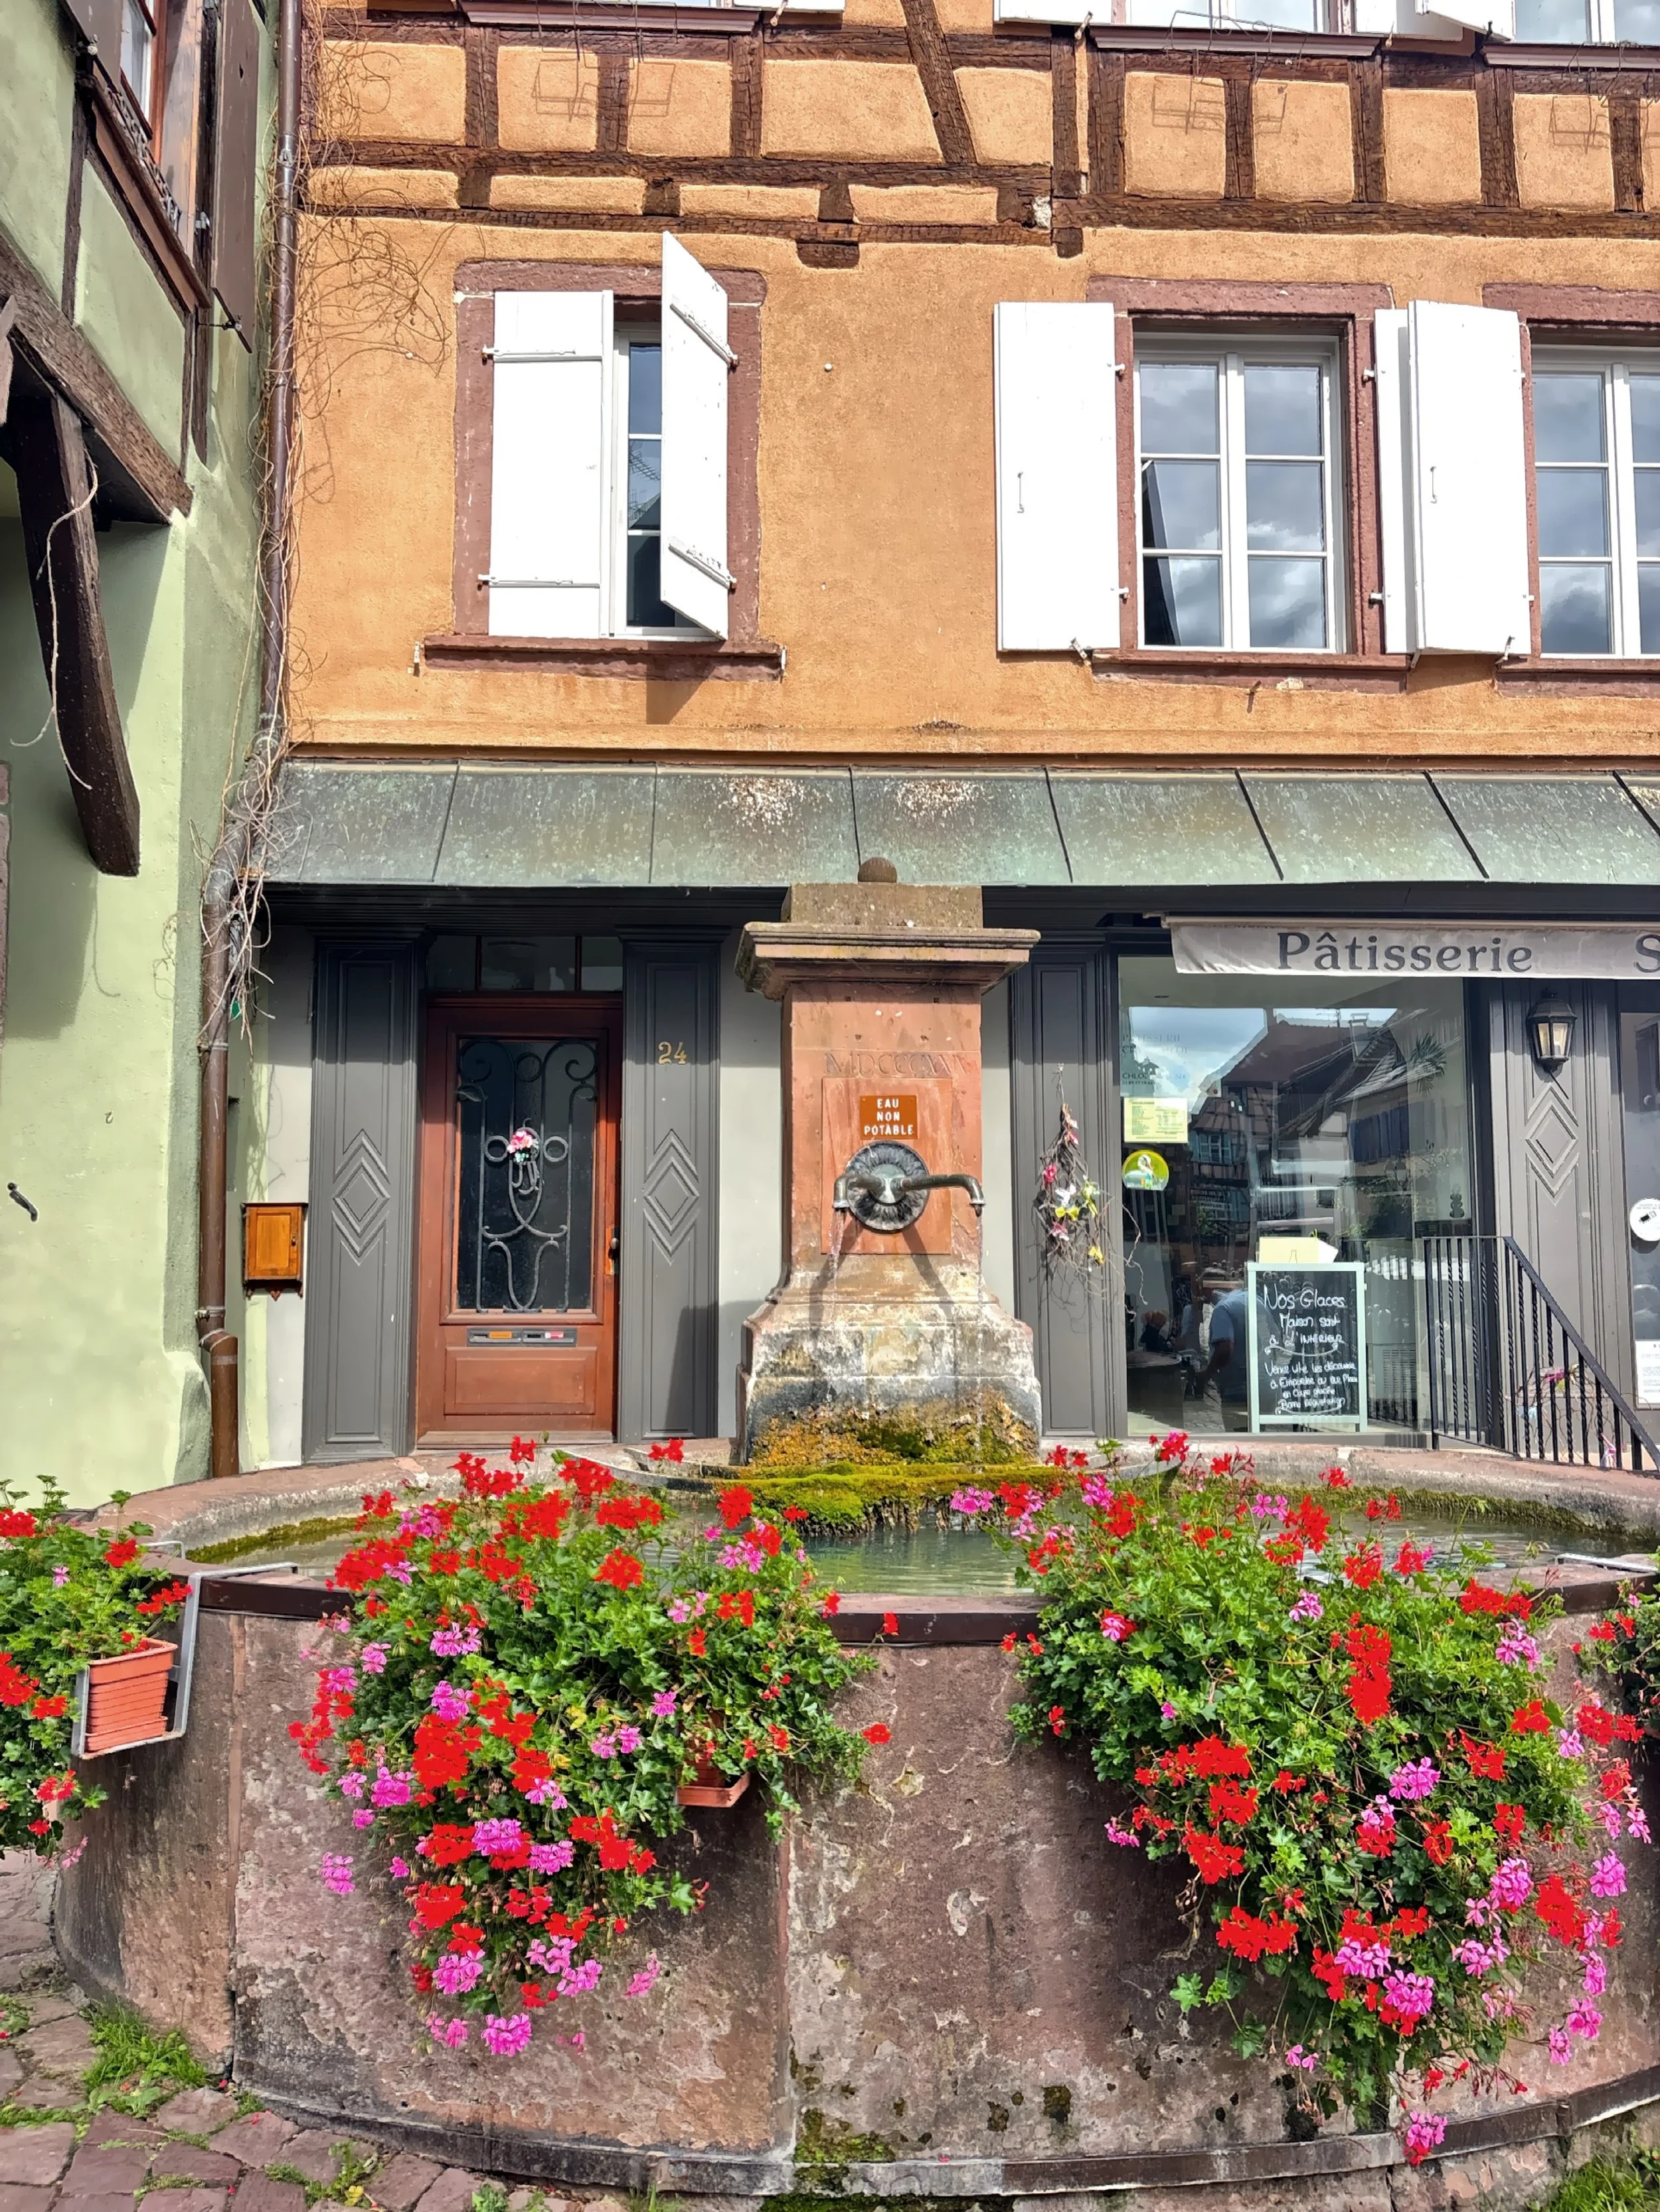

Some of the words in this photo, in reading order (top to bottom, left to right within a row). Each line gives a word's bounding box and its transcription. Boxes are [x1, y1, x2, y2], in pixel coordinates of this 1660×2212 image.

[1278, 932, 1533, 973] Pâtisserie
[659, 1041, 687, 1065] 24
[877, 1098, 899, 1109] EAU
[876, 1111, 900, 1121] NON
[864, 1123, 914, 1136] POTABLE
[1264, 1283, 1295, 1310] Nos
[1299, 1289, 1346, 1308] Glaces
[1279, 1309, 1313, 1334] Maison
